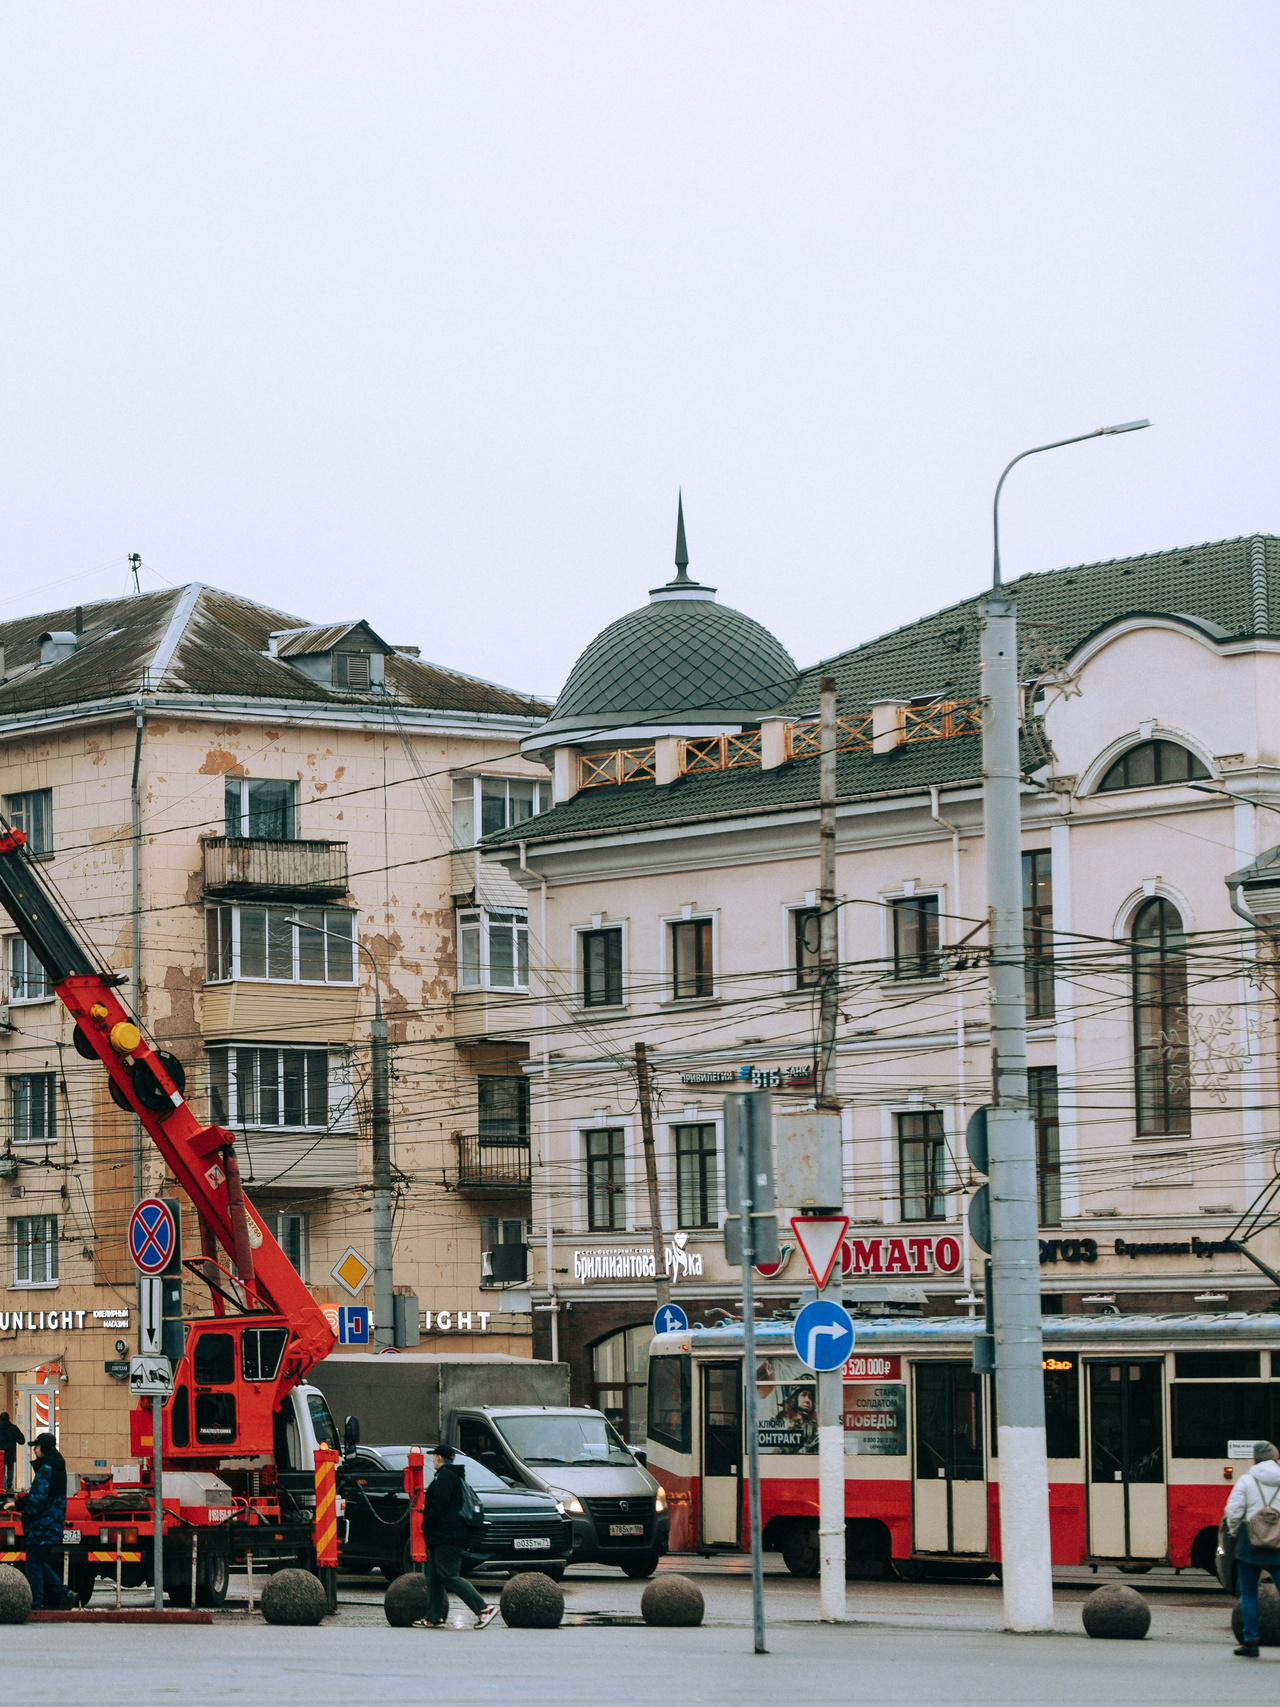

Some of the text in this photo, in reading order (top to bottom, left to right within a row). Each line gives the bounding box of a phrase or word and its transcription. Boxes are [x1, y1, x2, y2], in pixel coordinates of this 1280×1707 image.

[680, 1071, 733, 1083] ПРИВИЛЕГИЯ
[751, 1068, 780, 1088] ВТБ
[808, 1235, 962, 1274] MATO
[574, 1250, 656, 1285] Бриллиантова
[92, 1307, 129, 1318] ЮВЕЛИРНЫЙ
[103, 1319, 129, 1328] МАГАЗИН
[848, 1358, 866, 1375] 520
[874, 1388, 898, 1397] СТАНЬ
[856, 1399, 898, 1409] СОЛДАТОМ
[845, 1414, 897, 1429] ПОБЕДЫ
[758, 1432, 802, 1445] ОНТРАКТ
[70, 1530, 79, 1538] 71
